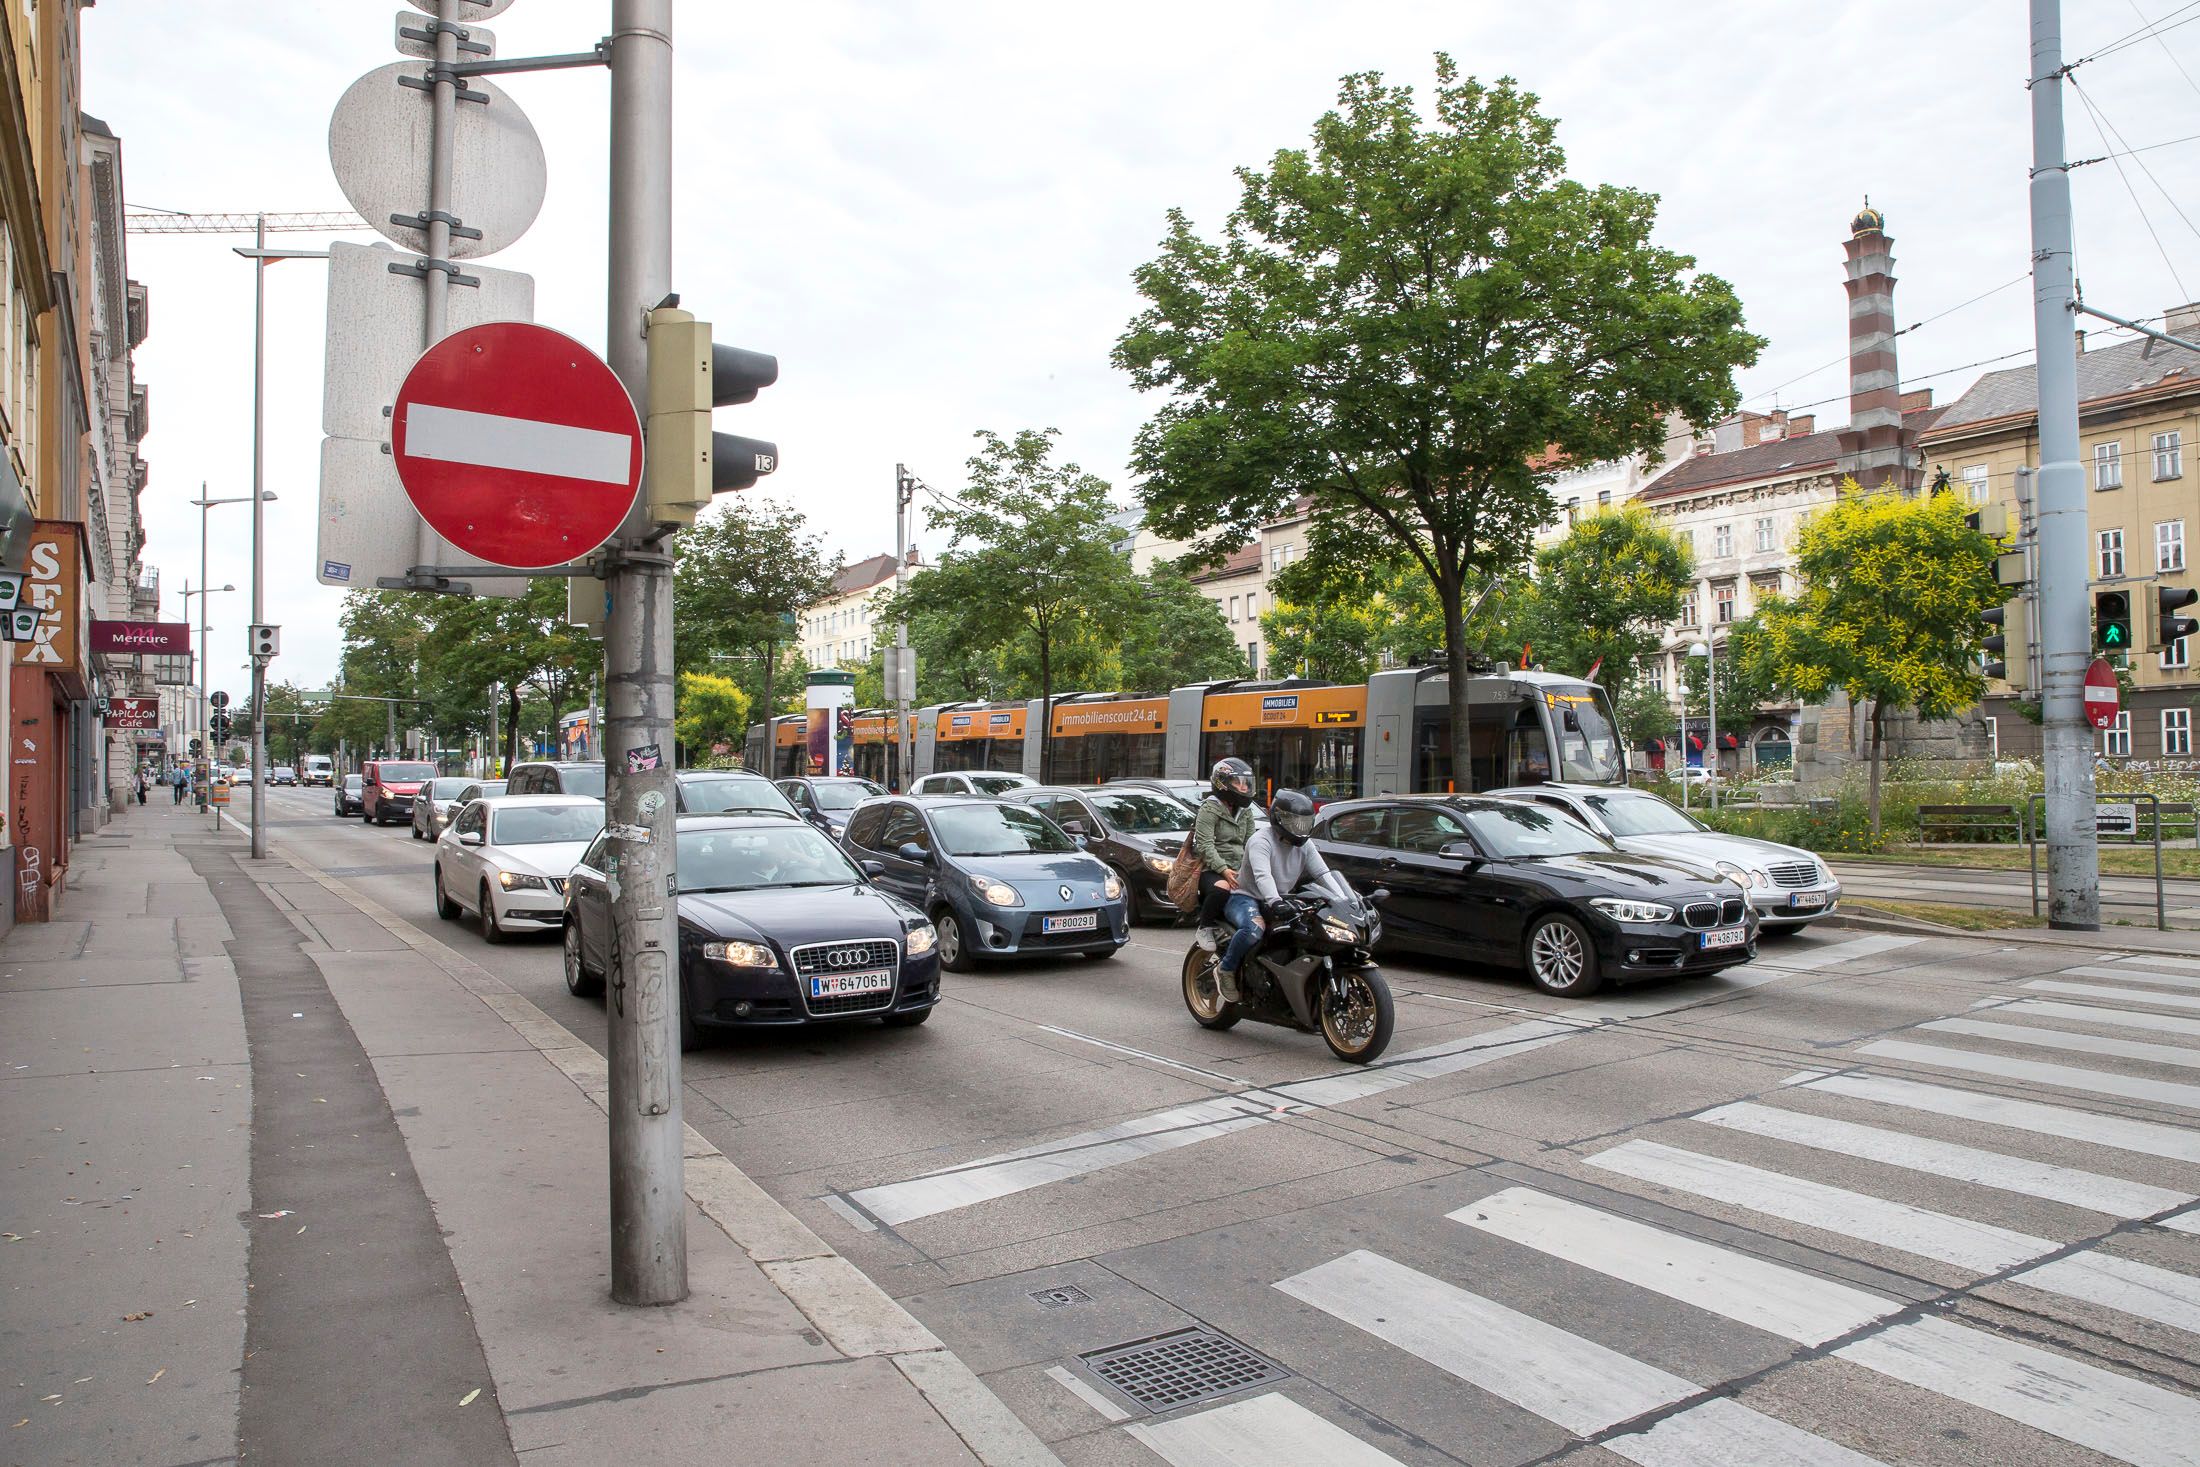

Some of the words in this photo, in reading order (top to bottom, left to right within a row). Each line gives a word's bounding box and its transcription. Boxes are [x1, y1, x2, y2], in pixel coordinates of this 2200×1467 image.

[757, 455, 772, 471] 13
[22, 542, 63, 663] SEX
[112, 634, 168, 644] Mercure
[1264, 699, 1296, 708] IMMOBILIEN
[106, 710, 156, 719] PAPILLON
[1062, 709, 1158, 726] immobilienscout24.at
[119, 719, 143, 728] Café
